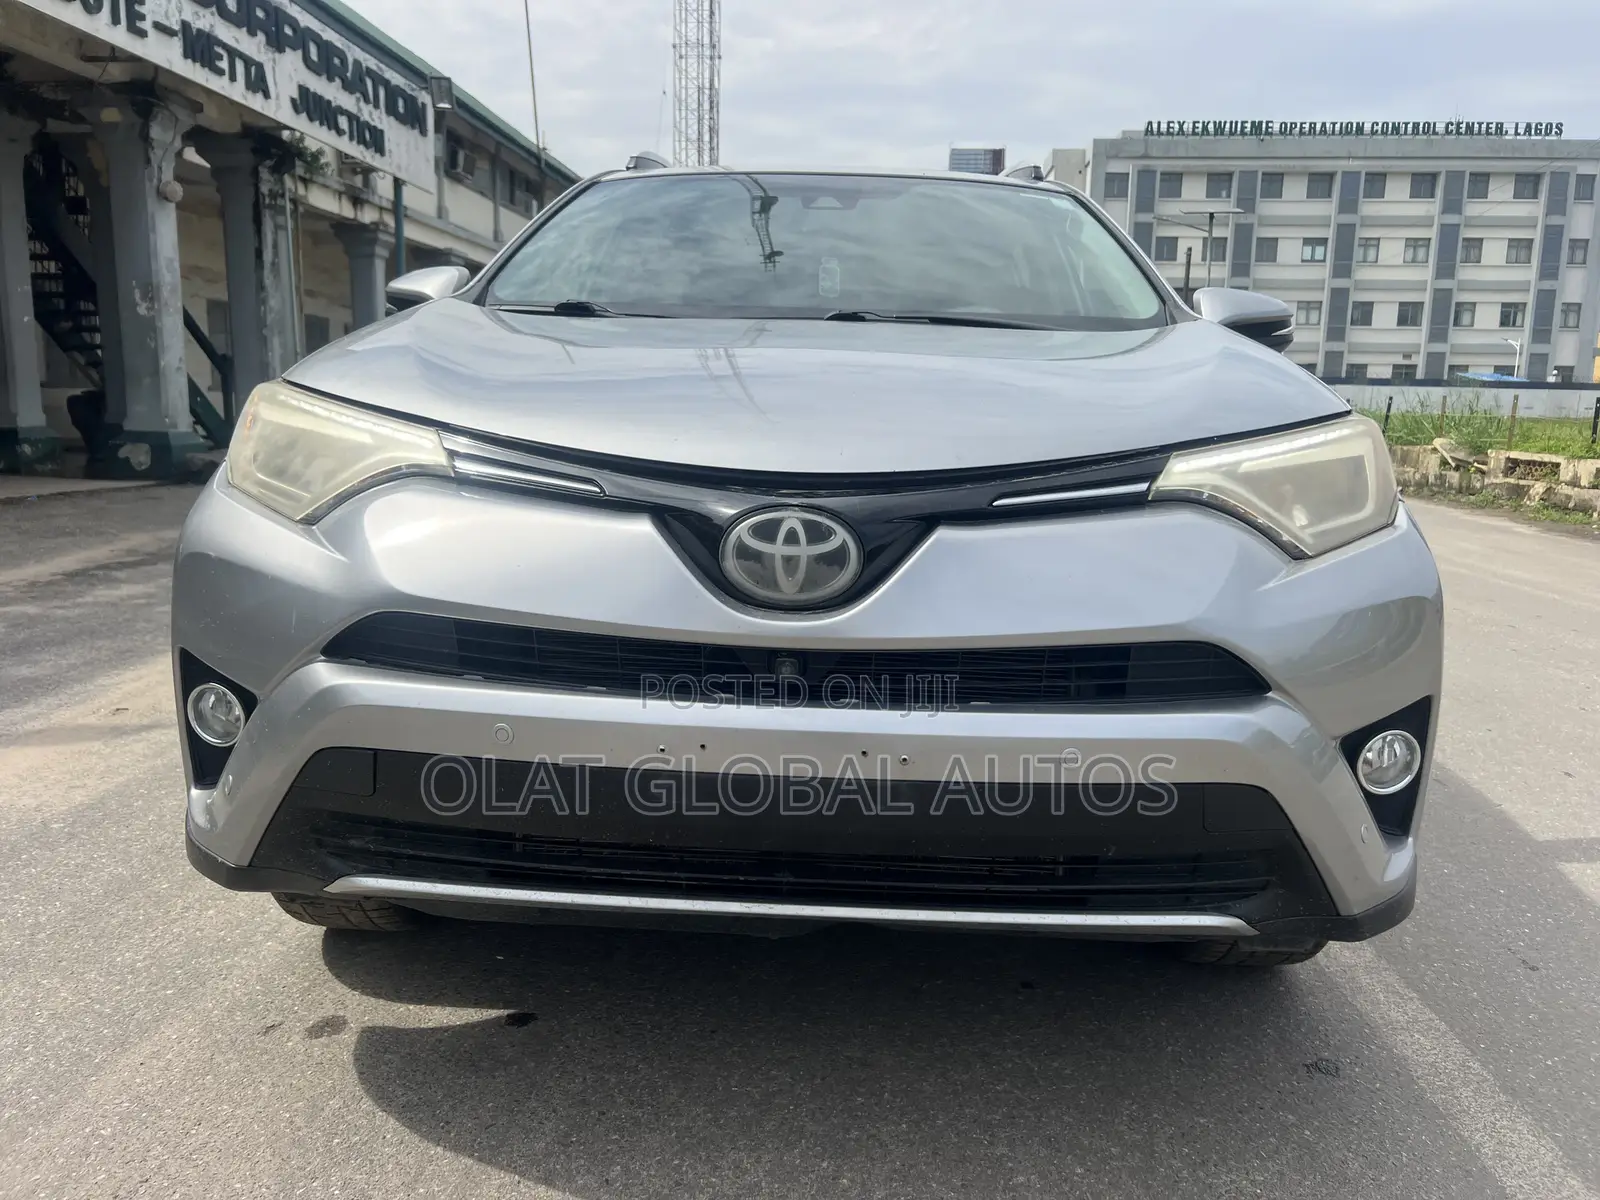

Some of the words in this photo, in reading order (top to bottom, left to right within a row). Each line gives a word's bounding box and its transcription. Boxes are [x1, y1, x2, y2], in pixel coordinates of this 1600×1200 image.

[189, 0, 428, 138] ORPORATION
[290, 83, 386, 157] JUNCTION
[1144, 120, 1187, 136] ALEX
[1191, 120, 1274, 136] EKWUEME
[1278, 121, 1365, 136] OPERATION
[1370, 121, 1439, 136] CONTROL
[1445, 121, 1509, 136] CENTER,
[1514, 121, 1564, 136] LAGOS
